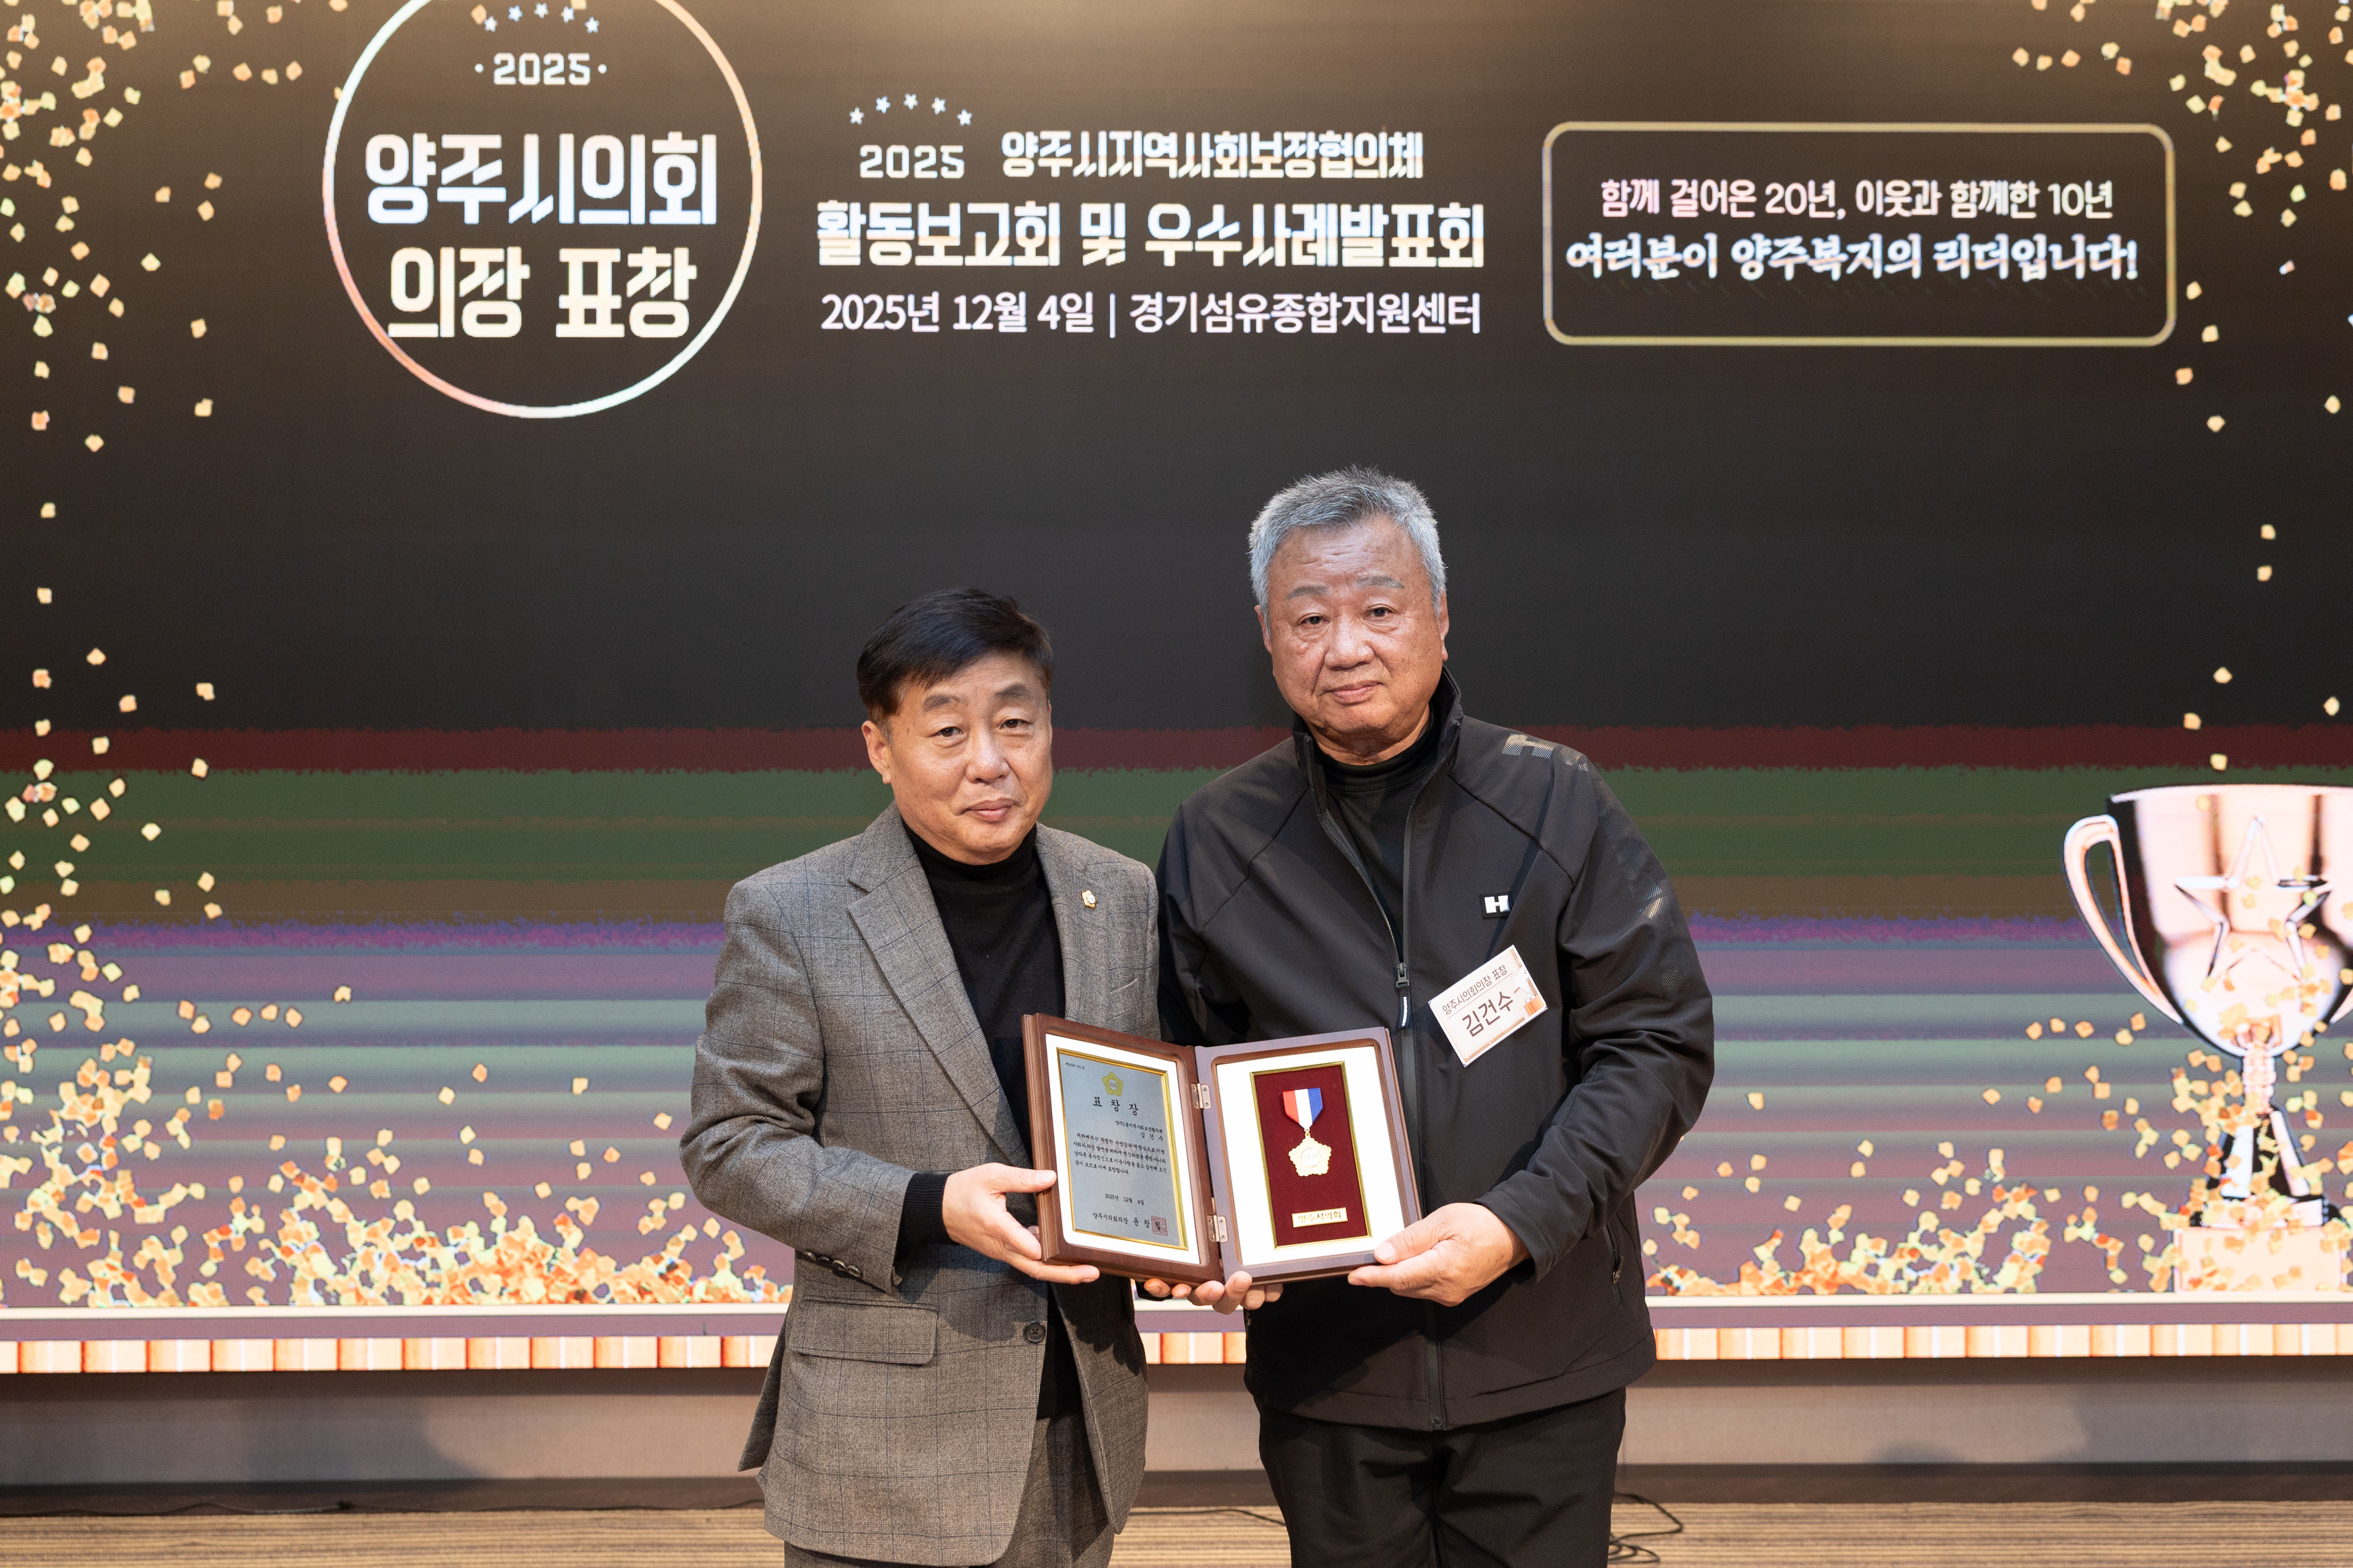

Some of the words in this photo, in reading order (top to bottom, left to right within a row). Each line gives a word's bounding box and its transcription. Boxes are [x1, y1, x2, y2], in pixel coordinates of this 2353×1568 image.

[365, 132, 717, 224] 양주시의회
[860, 145, 965, 179] 2025
[1001, 130, 1423, 179] 양주시지역사회보장협의체
[1601, 179, 1660, 217] 함께
[1671, 179, 1757, 217] 걸어온
[1765, 180, 1846, 220] 20년,
[1856, 179, 1942, 217] 이웃과
[1950, 180, 2040, 218] 함께한
[2048, 180, 2113, 218] 10년
[817, 200, 1061, 266] 활동보고회
[1080, 202, 1126, 266] 및
[1145, 202, 1484, 267] 우수사례발표회
[1566, 232, 1718, 280] 여러분이
[1730, 233, 1921, 281] 양주복지의
[1933, 233, 2139, 282] 리더입니다!
[388, 247, 530, 337] 의장
[556, 247, 697, 337] 표창
[821, 292, 940, 333] 2025년
[953, 292, 1027, 333] 12월
[1037, 292, 1094, 333] 4일
[1129, 292, 1480, 334] 경기섬유종합지원센터
[1484, 895, 1511, 913] H
[1442, 975, 1492, 1015] 양주시의회의장
[1491, 964, 1508, 981] 표창
[1462, 991, 1513, 1037] 김건수
[1298, 1210, 1341, 1224] 양주시의회
